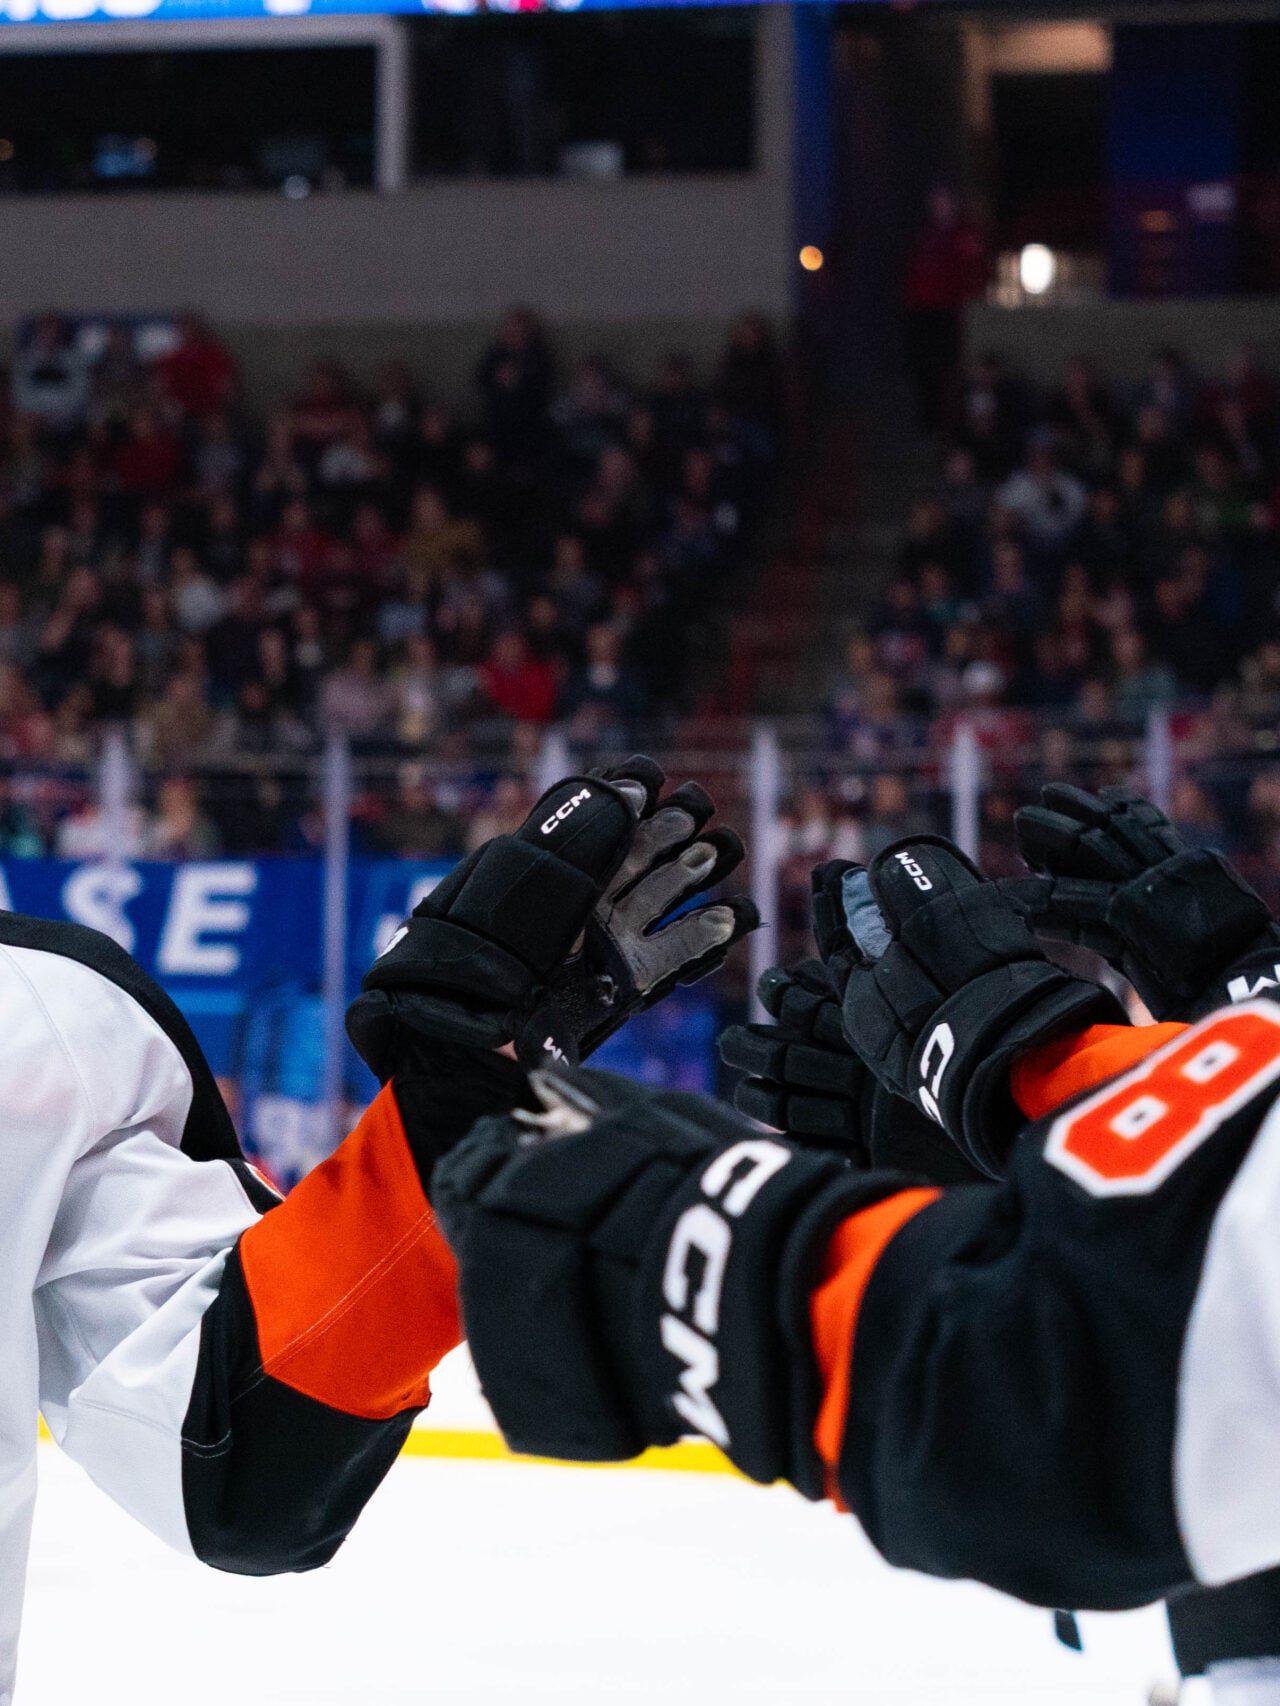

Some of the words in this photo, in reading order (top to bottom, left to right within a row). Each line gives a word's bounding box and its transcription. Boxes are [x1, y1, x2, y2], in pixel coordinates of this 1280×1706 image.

[540, 788, 591, 835] CCM
[894, 851, 933, 891] CCM
[1043, 998, 1280, 1198] 8
[660, 1140, 792, 1448] CCM
